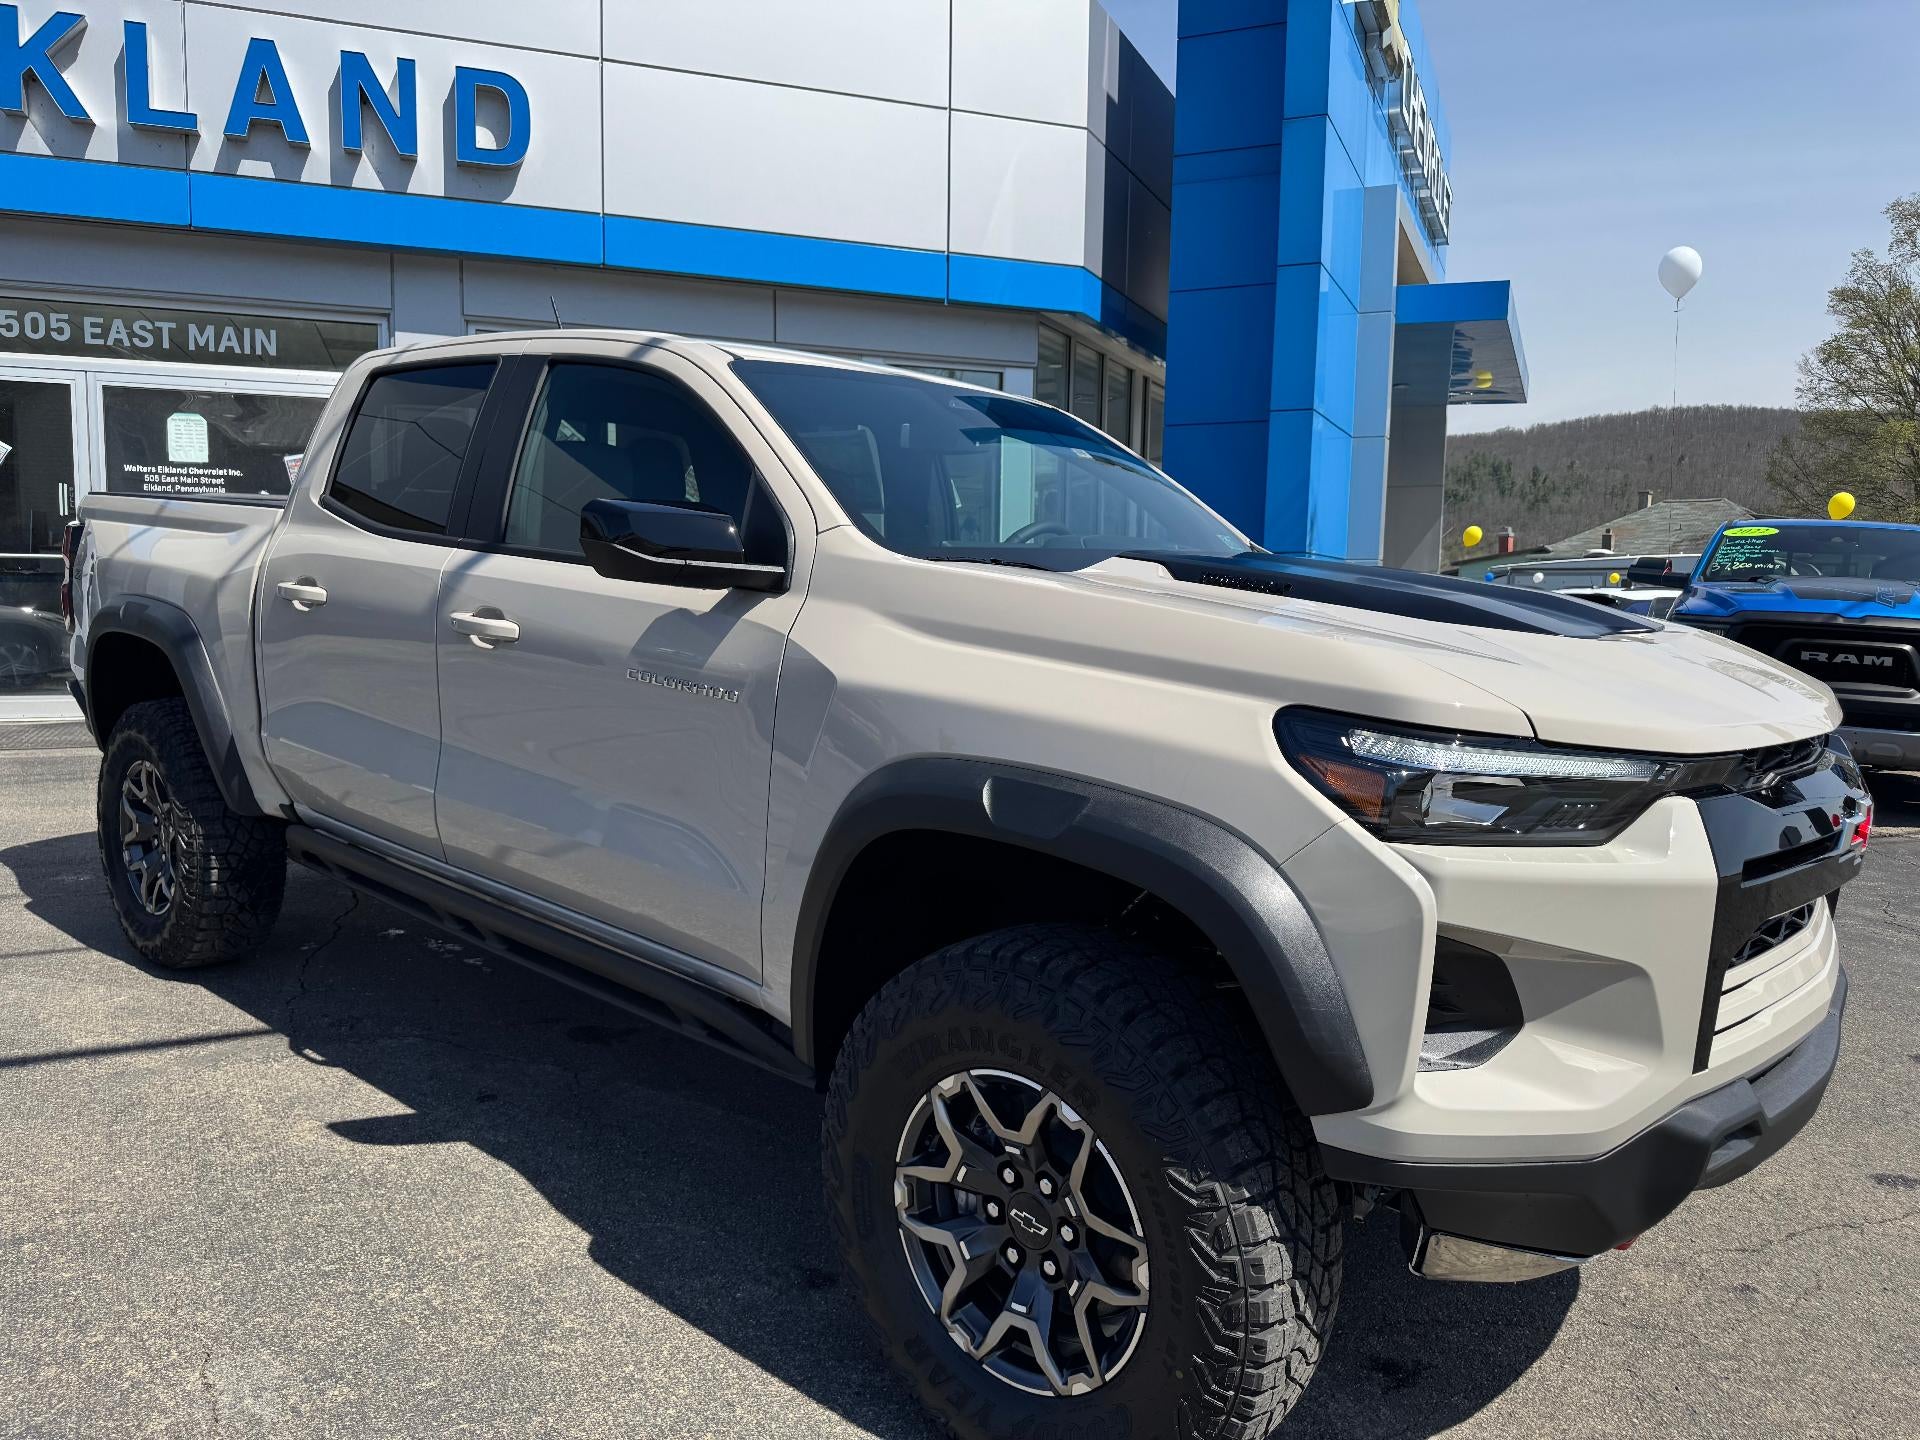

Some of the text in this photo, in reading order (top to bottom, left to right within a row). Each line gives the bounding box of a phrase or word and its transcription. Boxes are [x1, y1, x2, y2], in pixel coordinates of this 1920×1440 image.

[0, 309, 277, 357] 505 EAST MAIN
[123, 464, 156, 474] Walters
[157, 465, 187, 475] Elkland
[188, 467, 227, 476] Chevrolet
[144, 474, 225, 486] 505 East Main Street
[175, 485, 226, 494] Pennsylvania
[1800, 651, 1893, 667] RAM
[626, 668, 739, 703] COLORADO
